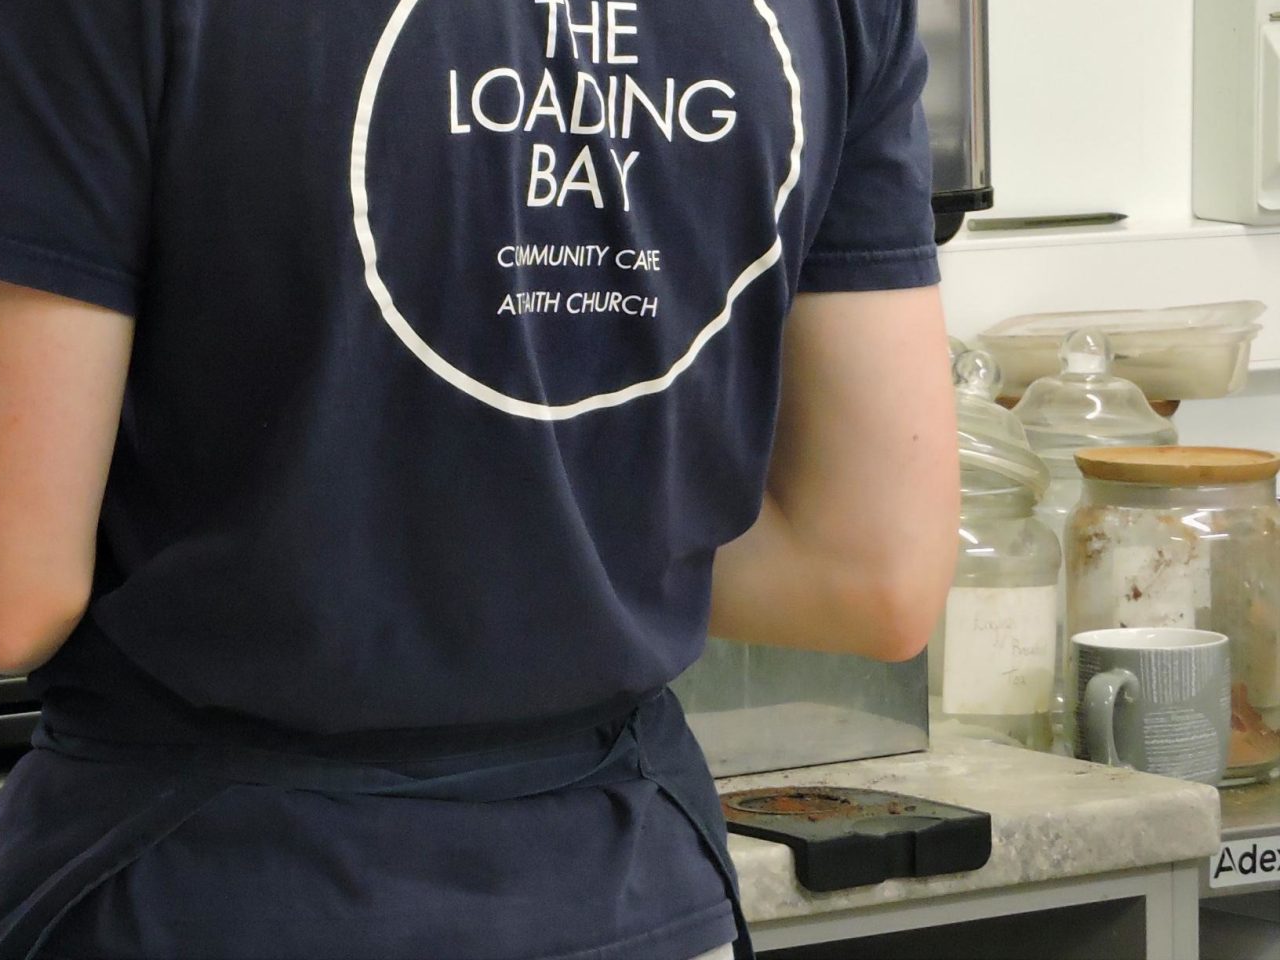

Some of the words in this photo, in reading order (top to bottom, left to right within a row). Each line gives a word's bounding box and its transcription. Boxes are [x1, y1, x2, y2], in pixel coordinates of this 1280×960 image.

[449, 67, 737, 142] LOADING
[526, 144, 639, 211] BAY
[615, 249, 661, 271] CAFE
[497, 293, 524, 315] AT
[566, 291, 658, 318] CHURCH
